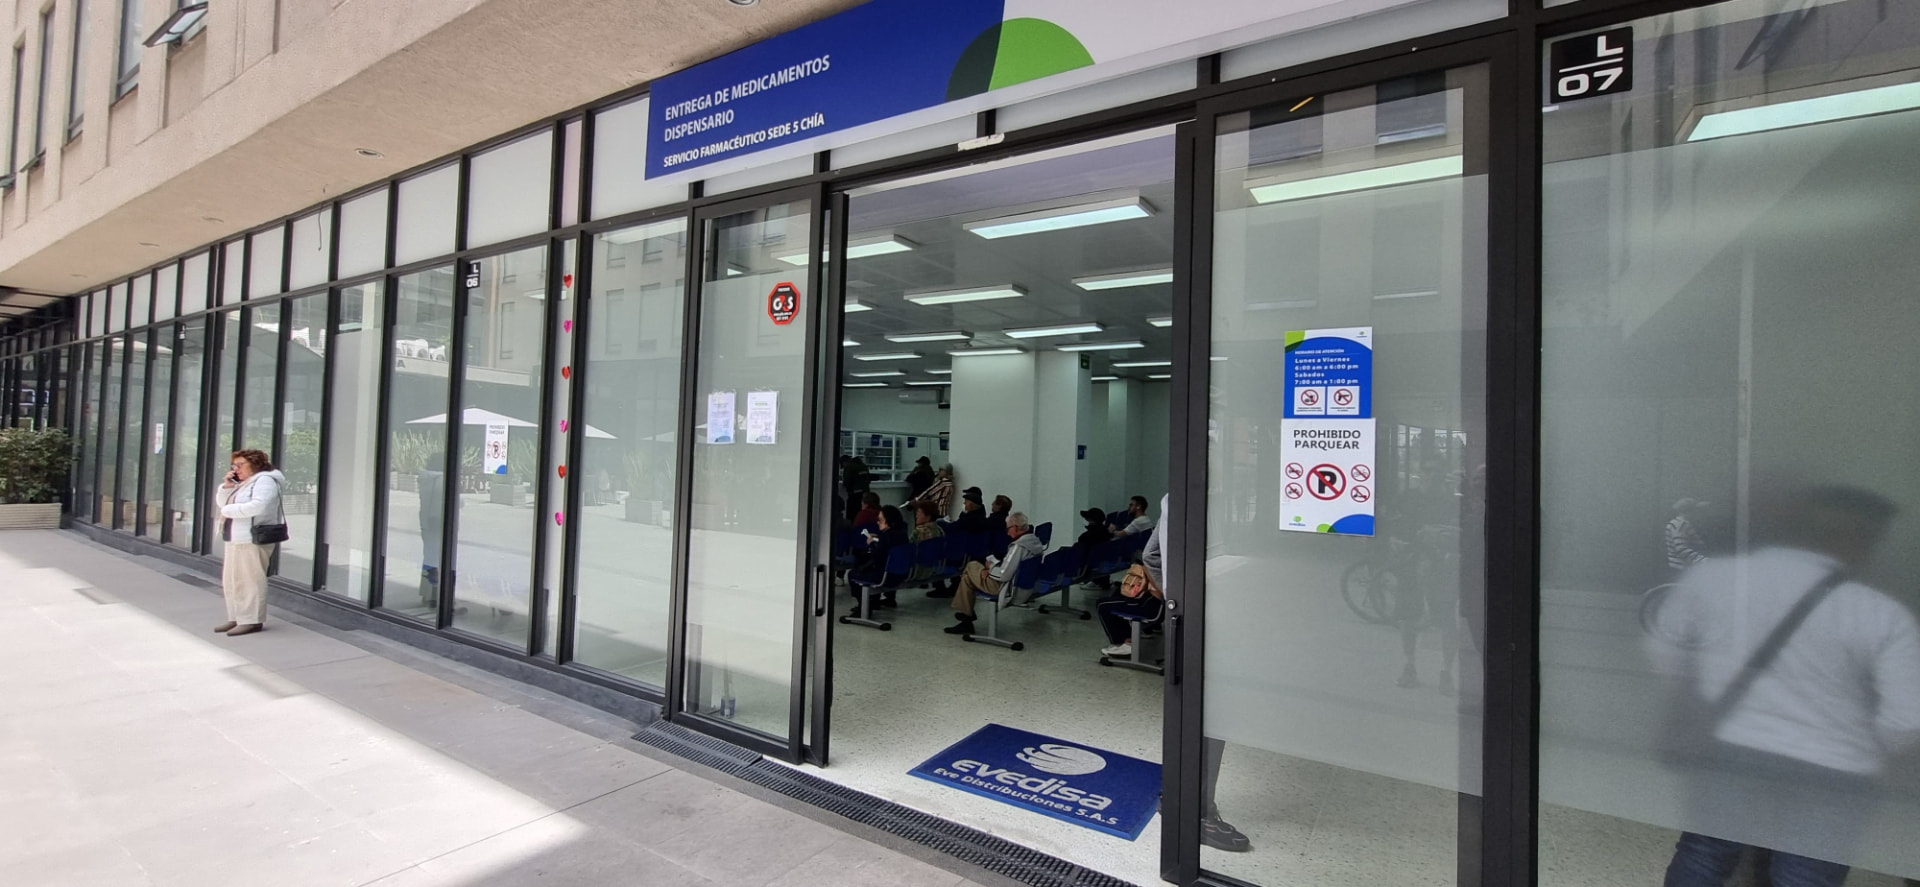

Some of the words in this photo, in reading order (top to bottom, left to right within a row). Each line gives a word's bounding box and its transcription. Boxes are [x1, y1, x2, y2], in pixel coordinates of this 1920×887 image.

[1597, 35, 1624, 58] L
[665, 93, 712, 121] ENTREGA
[714, 88, 729, 106] DE
[731, 54, 831, 101] MEDICAMENTOS
[1558, 66, 1624, 97] 07
[663, 148, 699, 168] SERVICIO
[700, 129, 766, 158] FARMACÉUTICO
[767, 122, 792, 140] SEDE
[793, 120, 799, 133] 5
[800, 112, 825, 131] CHÍA
[664, 109, 735, 142] DISPENSARIO
[466, 278, 478, 288] 06
[473, 264, 479, 273] L
[1293, 429, 1361, 439] PROHIBIDO
[1294, 440, 1360, 451] PARQUEAR
[933, 767, 960, 780] Eve
[961, 774, 1073, 813] Distribuciones
[1074, 807, 1119, 826] S.A.S
[951, 759, 1112, 810] evedisa
